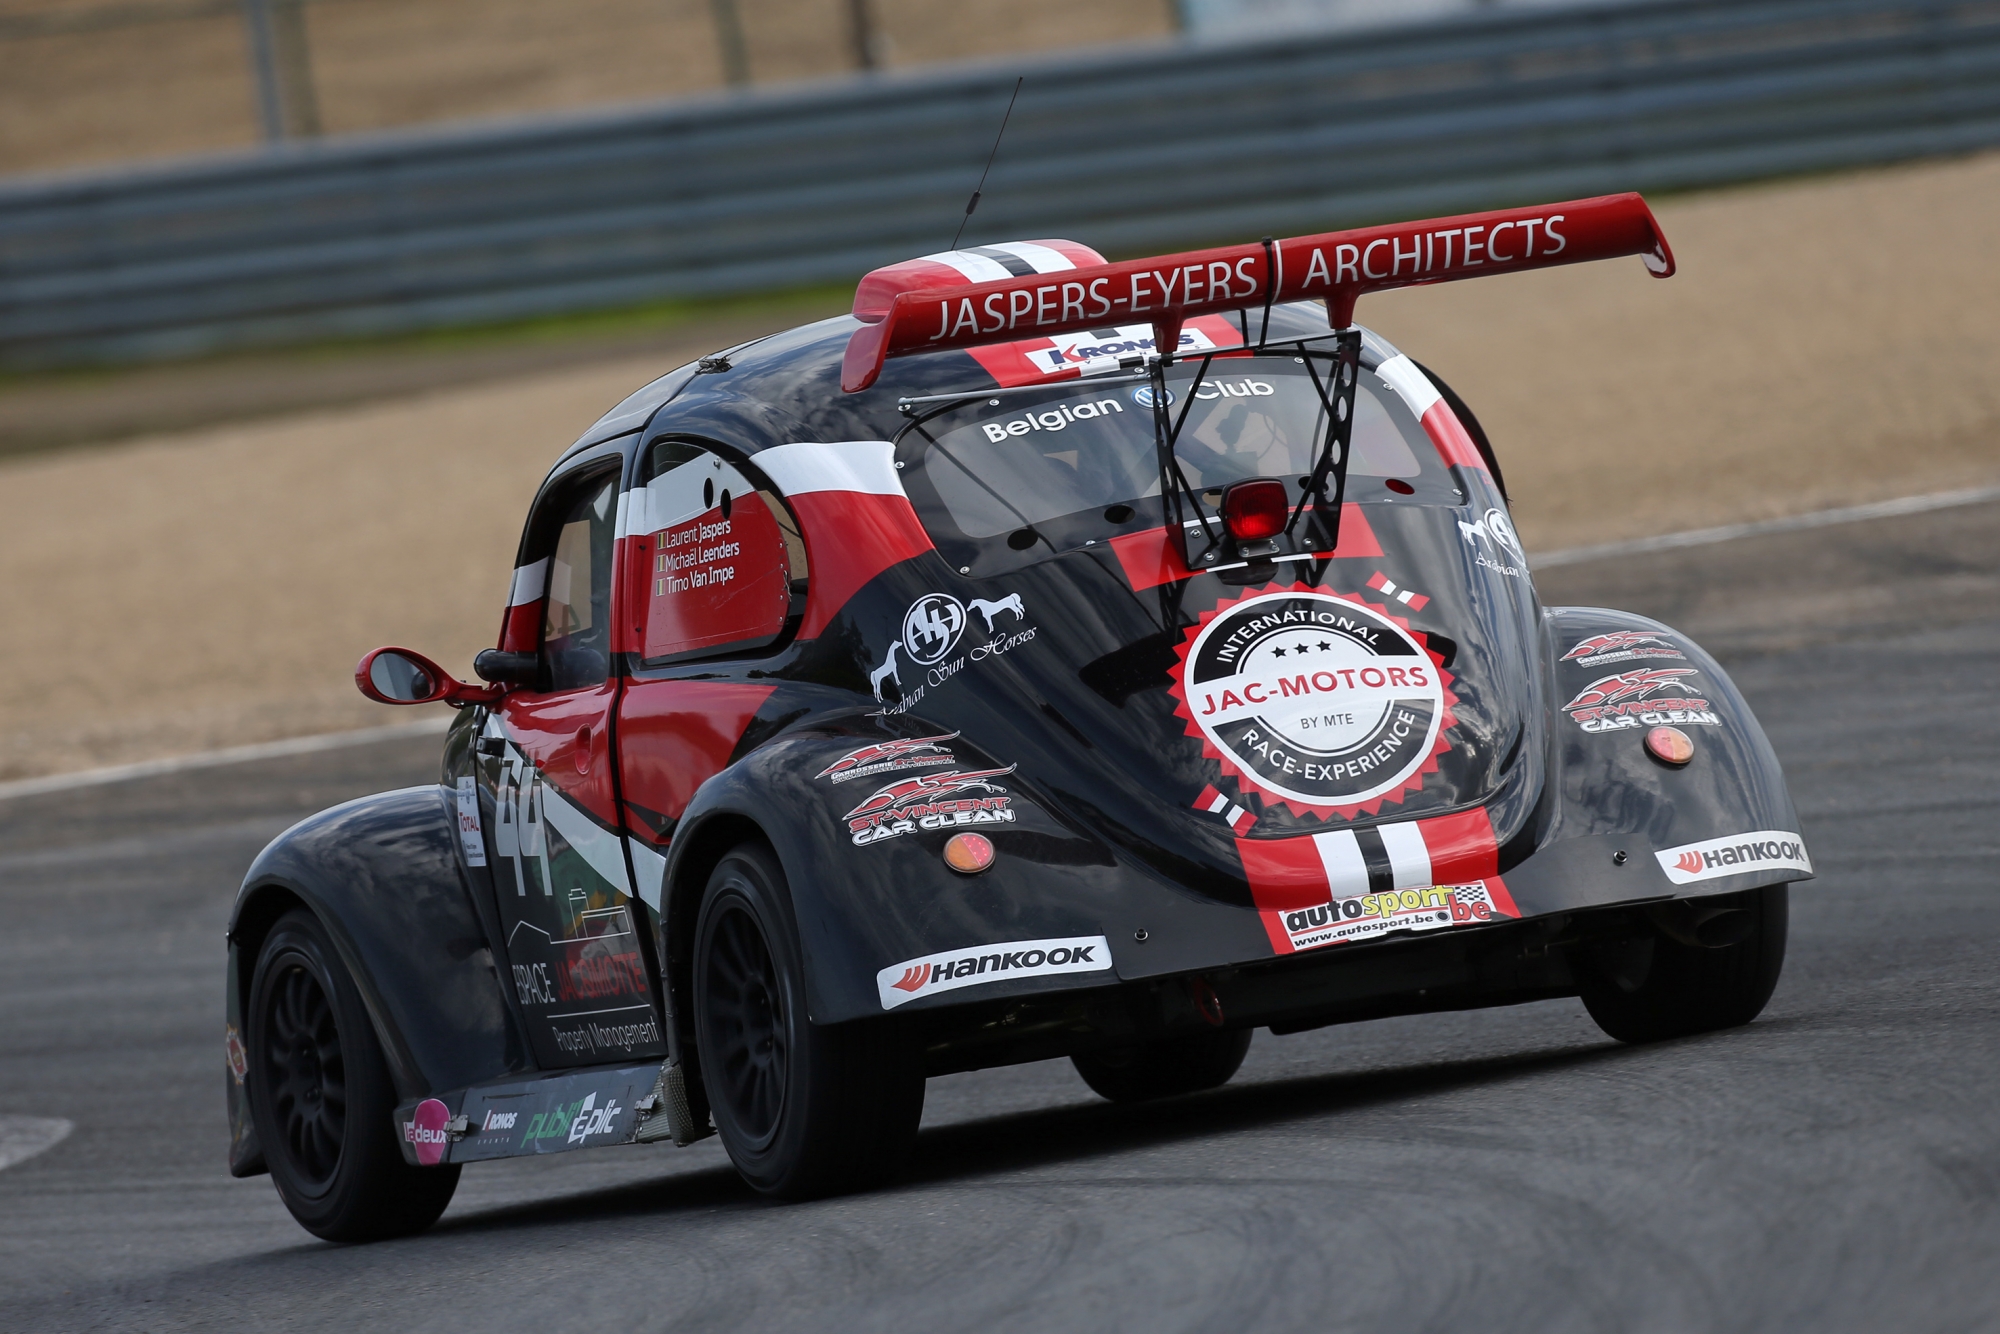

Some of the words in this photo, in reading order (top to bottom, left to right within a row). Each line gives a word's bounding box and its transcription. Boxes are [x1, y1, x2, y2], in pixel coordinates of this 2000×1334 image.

[930, 257, 1257, 341] JASPERS-EYERS
[1301, 215, 1566, 289] ARCHITECTS
[1048, 334, 1194, 365] KRONS
[982, 398, 1123, 444] Belgian
[1188, 378, 1274, 400] Club
[666, 527, 698, 548] Laurent
[698, 520, 731, 543] Jaspers
[665, 548, 698, 573] Michaël
[698, 541, 740, 562] Leenders
[666, 575, 689, 594] Timo
[690, 571, 708, 589] Van
[709, 565, 734, 585] Impe
[1216, 610, 1380, 663] INTERNATIONAL
[927, 656, 965, 687] Sun
[970, 626, 1037, 661] Horses
[1201, 666, 1429, 716] JAC-MOTORS
[1300, 716, 1319, 730] BY
[1324, 712, 1354, 728] MTE
[1570, 698, 1709, 722] ST-VINCENT
[1580, 715, 1642, 733] CAR
[1640, 711, 1722, 726] CLEAN
[1242, 709, 1416, 781] RACE-EXPERIENCE
[459, 811, 480, 832] TOTAL
[495, 766, 553, 896] 44
[849, 797, 1011, 833] ST-VINCENT
[852, 819, 917, 847] CAR
[919, 808, 1017, 831] CLEAN
[1294, 914, 1434, 947] www.autosport.be
[552, 1024, 596, 1056] Property
[588, 1015, 659, 1052] Management
